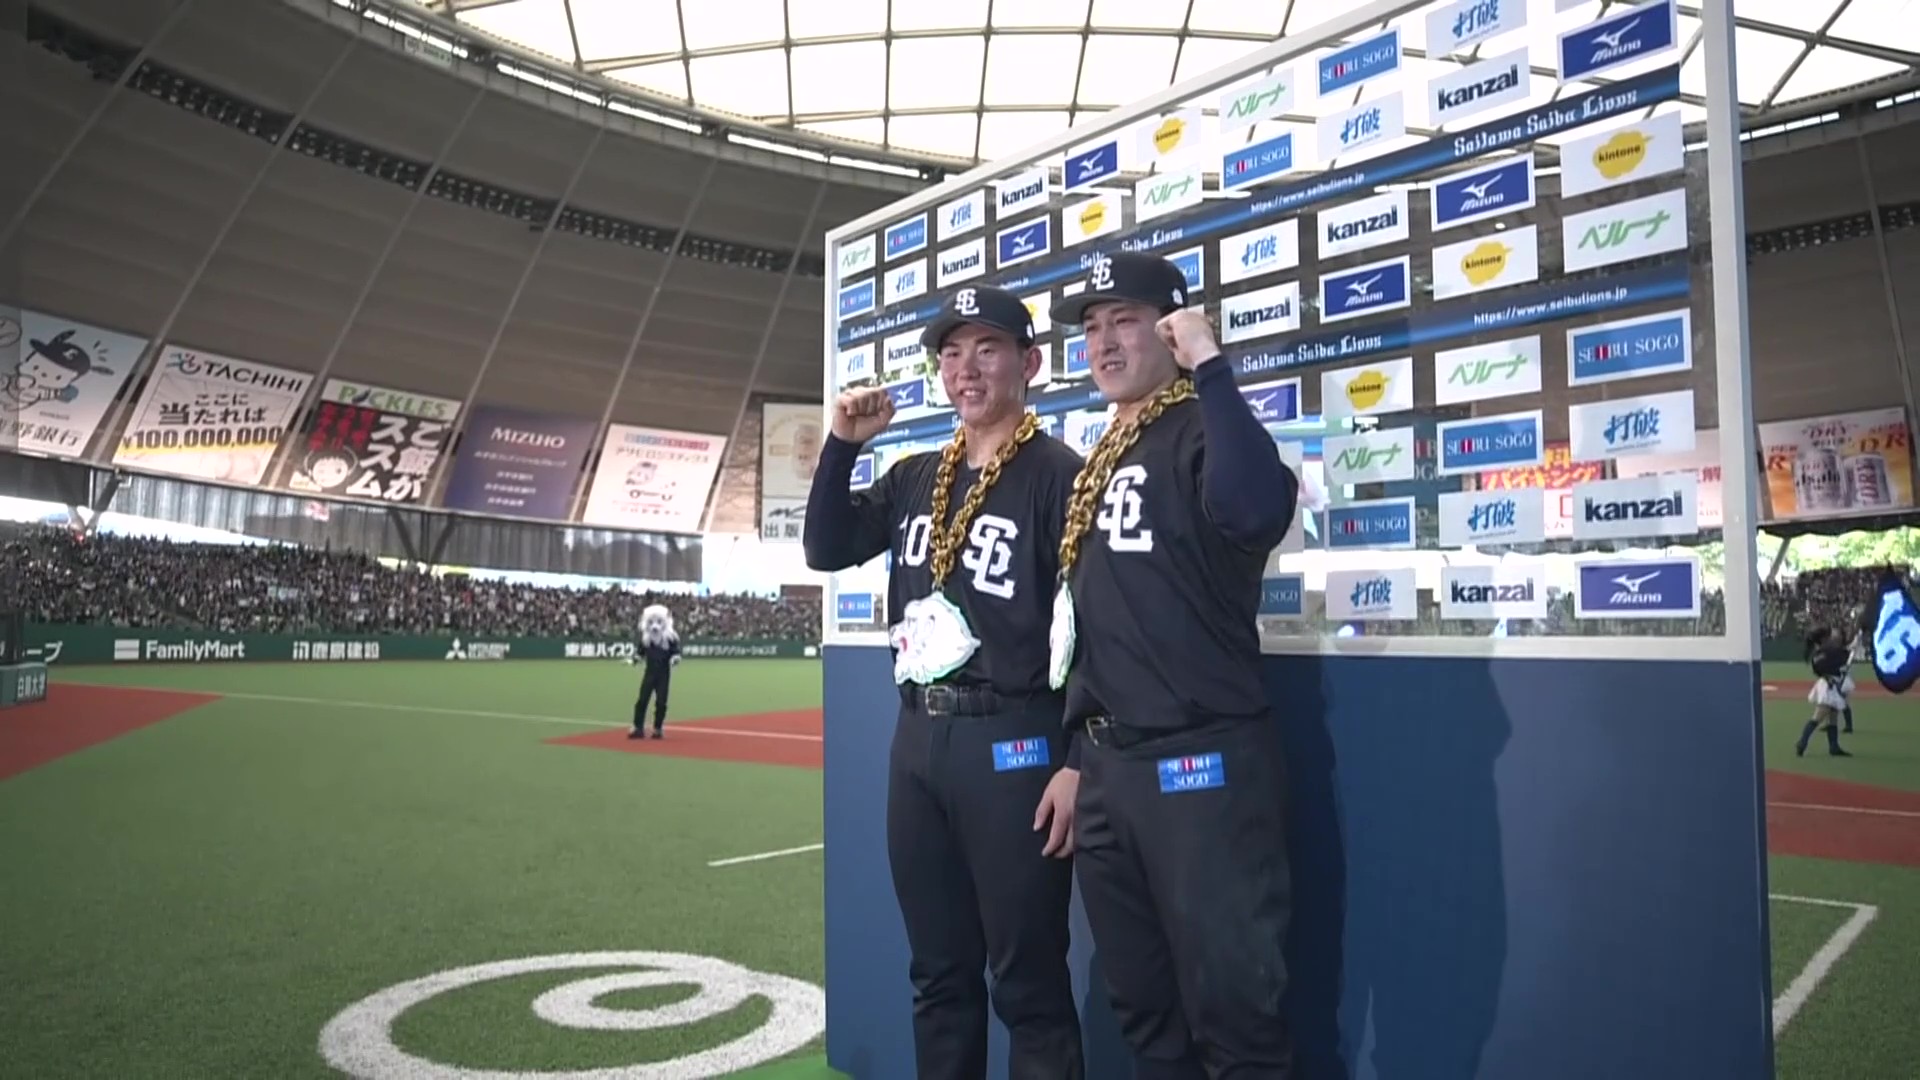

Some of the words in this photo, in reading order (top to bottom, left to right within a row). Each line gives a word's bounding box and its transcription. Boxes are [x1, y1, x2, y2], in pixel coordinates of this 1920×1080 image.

[1362, 45, 1394, 68] SOGO
[1227, 83, 1286, 119] ベルーナ
[1261, 147, 1288, 163] SOGO
[1598, 145, 1641, 163] kintone
[1144, 175, 1194, 206] ベルーナ
[1577, 210, 1671, 250] ベルーナ
[1465, 254, 1502, 270] kintone
[1578, 343, 1628, 362] SEIBU
[1635, 334, 1678, 354] SOGO
[202, 361, 304, 393] TACHIHI
[1448, 354, 1528, 385] ベルーナ
[194, 393, 249, 407] ここに
[159, 403, 267, 426] 当たれば
[1603, 407, 1660, 444] 打破
[123, 425, 283, 450] ¥100,000,000
[490, 427, 566, 449] MIZUHO
[1447, 436, 1489, 453] SEIBU
[1496, 433, 1532, 447] SOGO
[346, 415, 408, 497] ススム
[1333, 442, 1403, 469] ベルーナ
[1375, 516, 1407, 531] SOGO
[1468, 499, 1516, 531] 打破
[1350, 576, 1392, 606] 打破
[146, 639, 245, 661] FamilyMart
[1006, 754, 1037, 767] SOGO
[1173, 772, 1209, 788] SOGO
